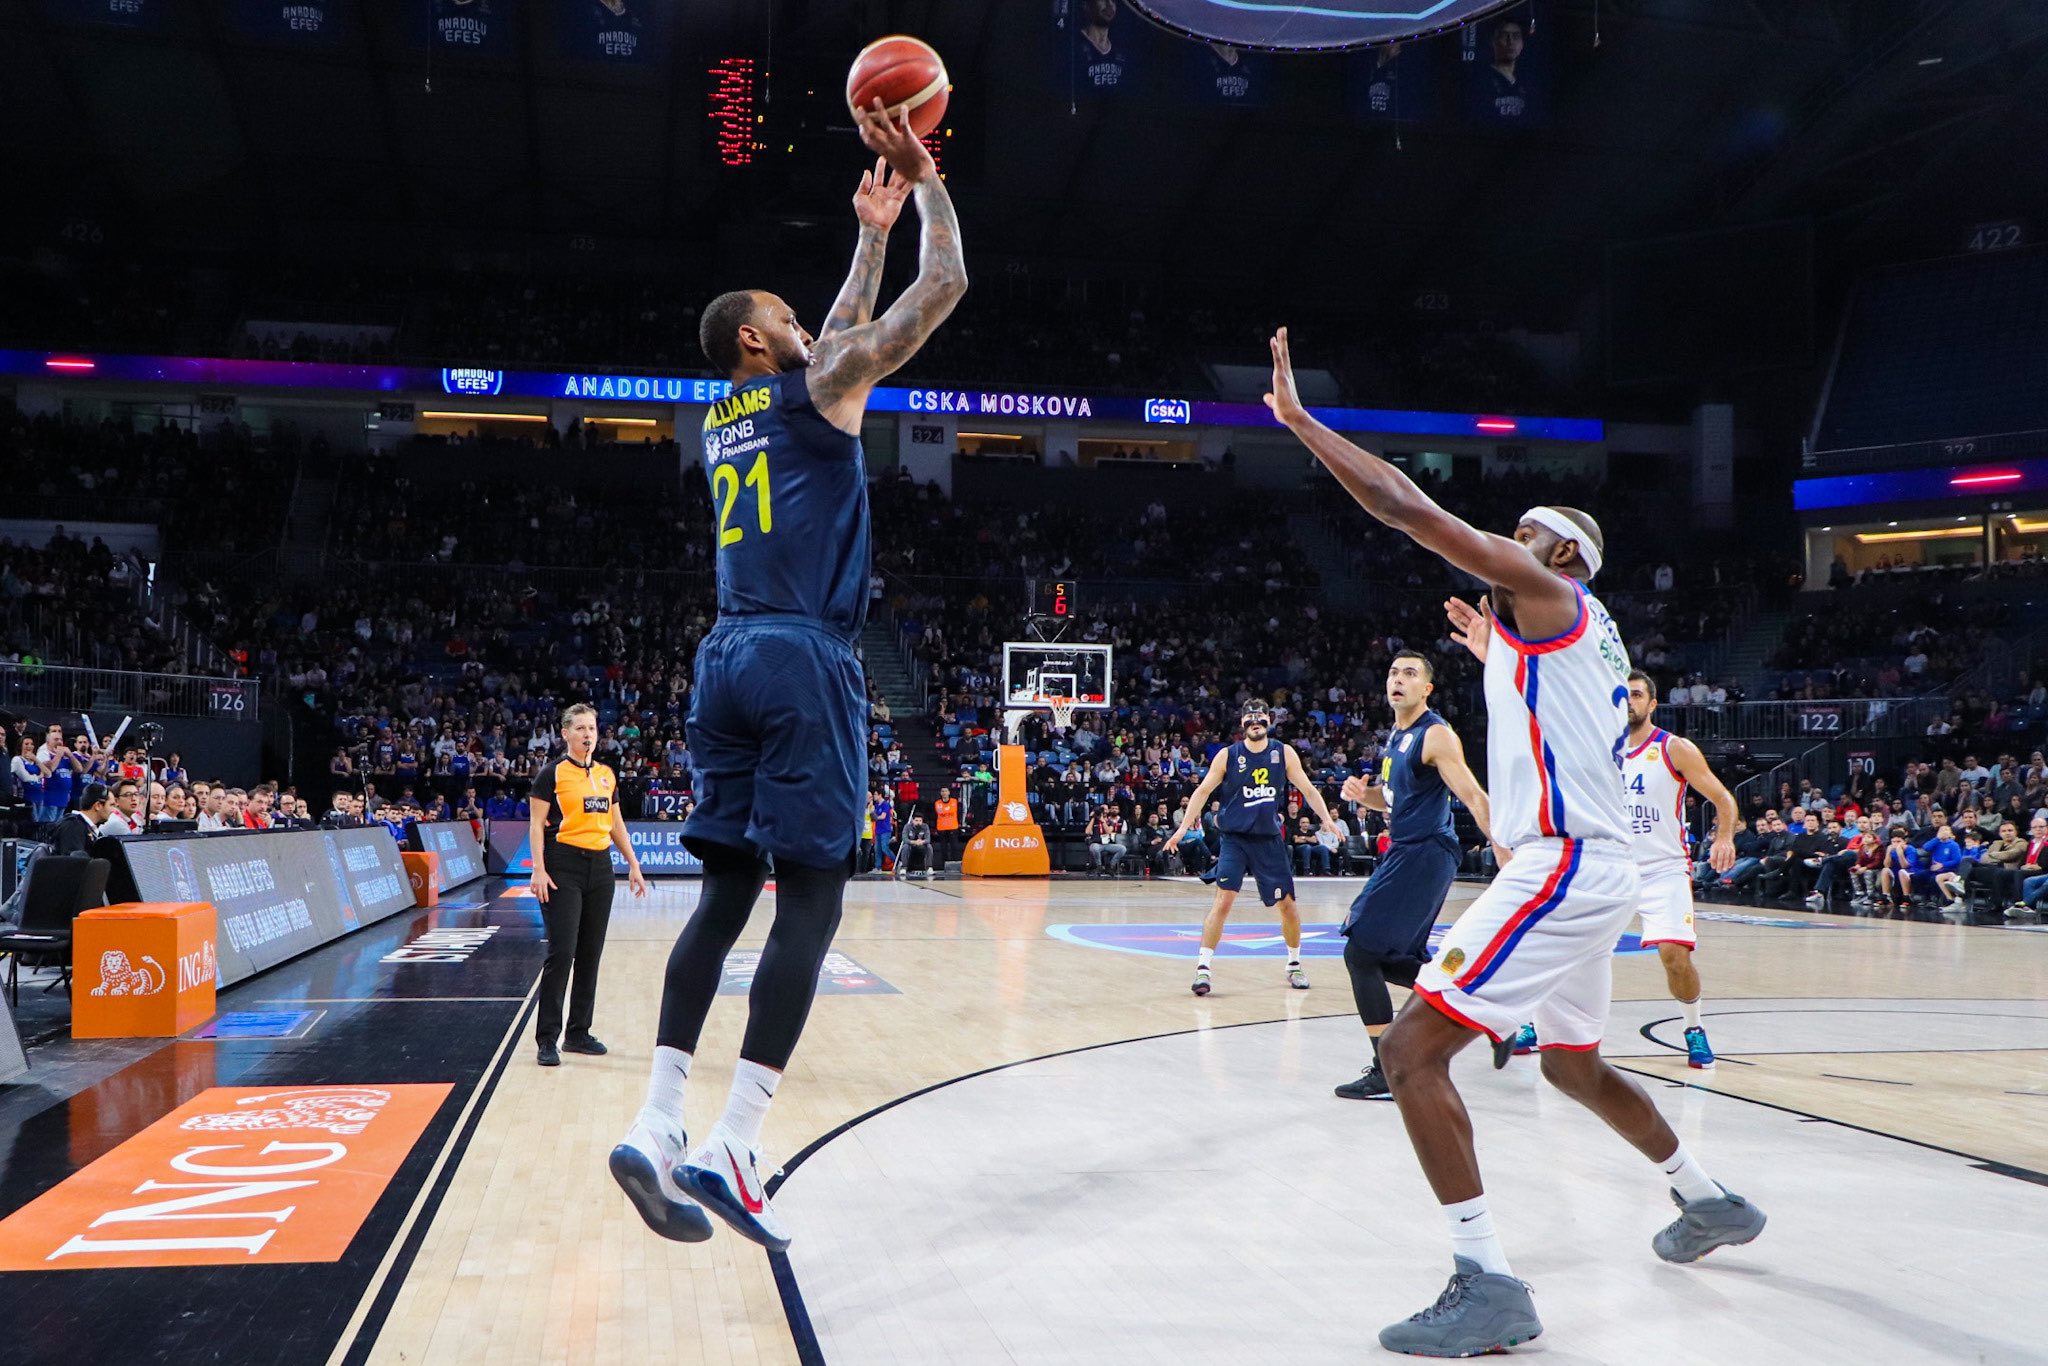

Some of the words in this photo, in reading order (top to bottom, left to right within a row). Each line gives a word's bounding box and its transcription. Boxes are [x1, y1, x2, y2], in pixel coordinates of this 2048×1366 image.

[437, 18, 487, 36] ANADOLU
[445, 30, 480, 44] EFES
[599, 32, 638, 47] ANADOLU
[606, 43, 632, 56] EFES
[1094, 75, 1117, 86] EFES
[1968, 225, 2020, 251] 422
[457, 379, 488, 390] EFES
[565, 376, 682, 400] ANADOLU
[908, 390, 970, 412] CSKA
[980, 393, 1092, 417] MOSKOVA
[1151, 405, 1184, 418] CSKA
[721, 419, 755, 445] QNB
[913, 427, 943, 443] 324
[722, 436, 770, 459] FINANSBANK
[713, 451, 773, 550] 21
[1054, 596, 1067, 615] 6
[212, 693, 245, 711] 126
[1801, 714, 1839, 730] 122
[1252, 767, 1270, 785] 12
[1622, 774, 1645, 795] 4
[1242, 784, 1277, 799] beko
[1632, 820, 1652, 834] ES
[993, 838, 1021, 849] ING
[179, 952, 201, 993] ING
[45, 1140, 348, 1261] ING
